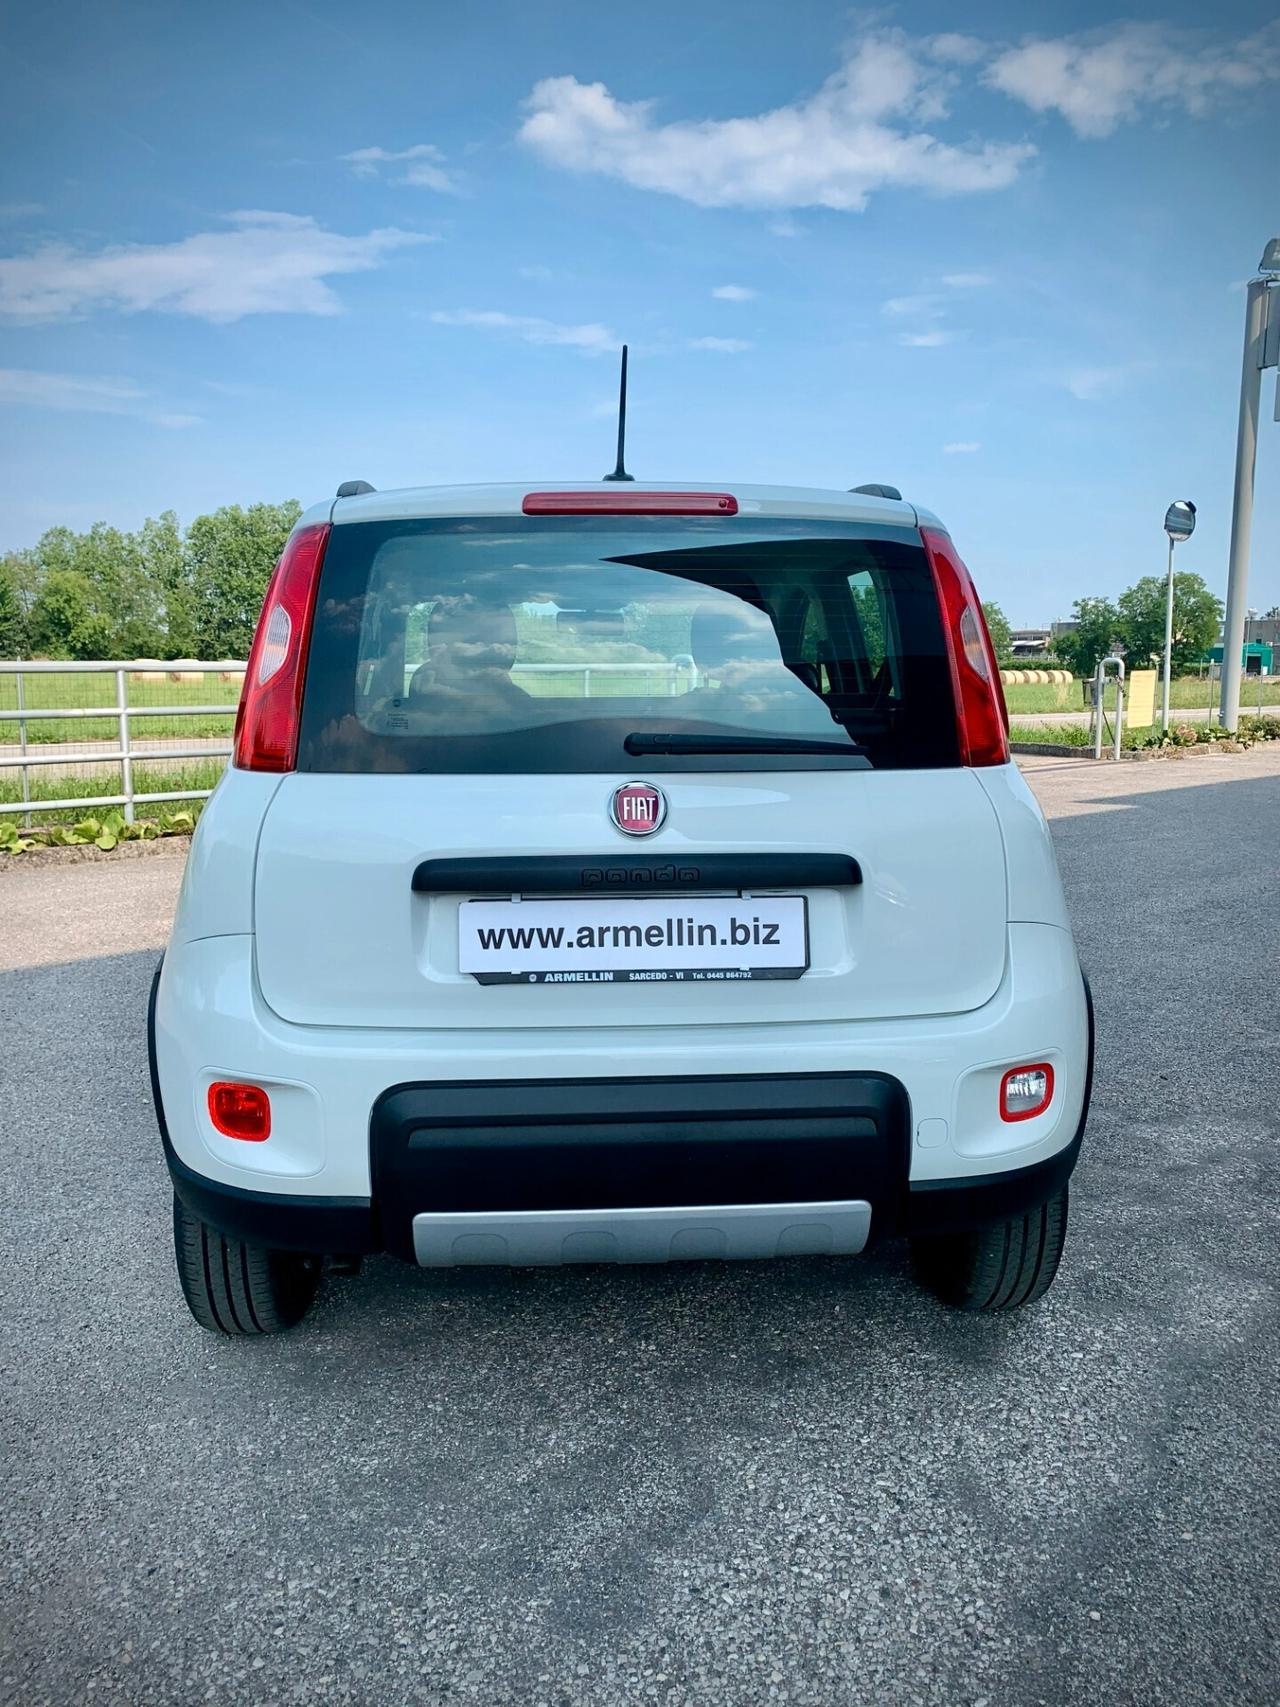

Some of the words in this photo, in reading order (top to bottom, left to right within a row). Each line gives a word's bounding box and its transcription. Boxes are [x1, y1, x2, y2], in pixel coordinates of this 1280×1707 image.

[623, 797, 655, 820] FIAT
[581, 864, 699, 887] panda
[477, 917, 780, 950] www.armellin.biz
[544, 971, 614, 982] ARMELLIN
[629, 972, 667, 980] SARCEDO
[675, 972, 684, 980] VI
